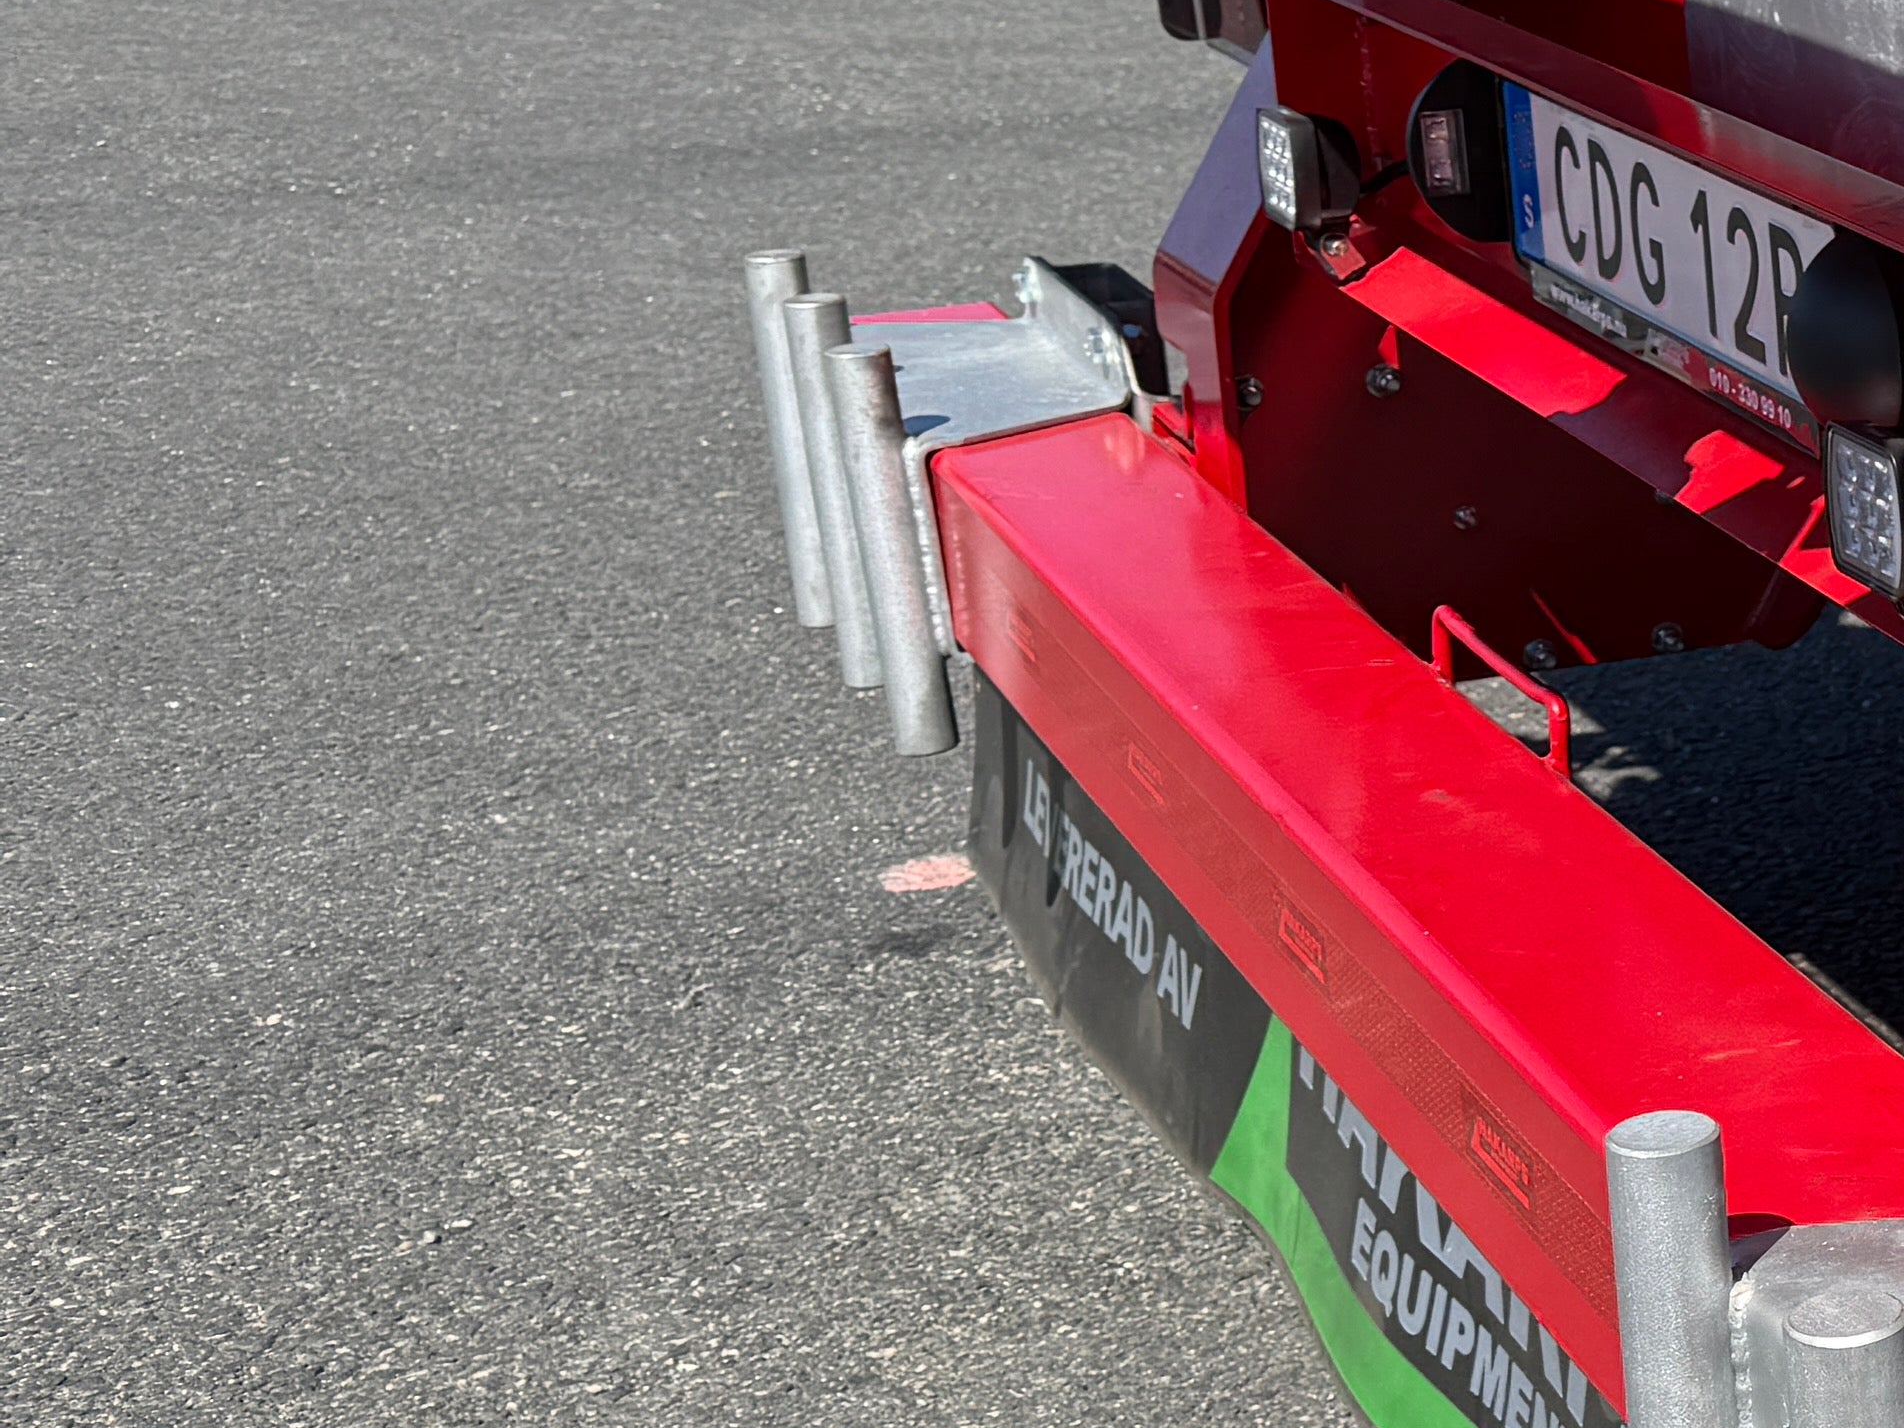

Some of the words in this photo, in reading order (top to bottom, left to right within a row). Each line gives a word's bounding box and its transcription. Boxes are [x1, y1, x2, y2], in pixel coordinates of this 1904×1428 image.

[1522, 193, 1534, 229] S
[1554, 124, 1667, 307] CDG
[1022, 758, 1155, 976] LEVERERAD
[1156, 933, 1203, 1031] AV
